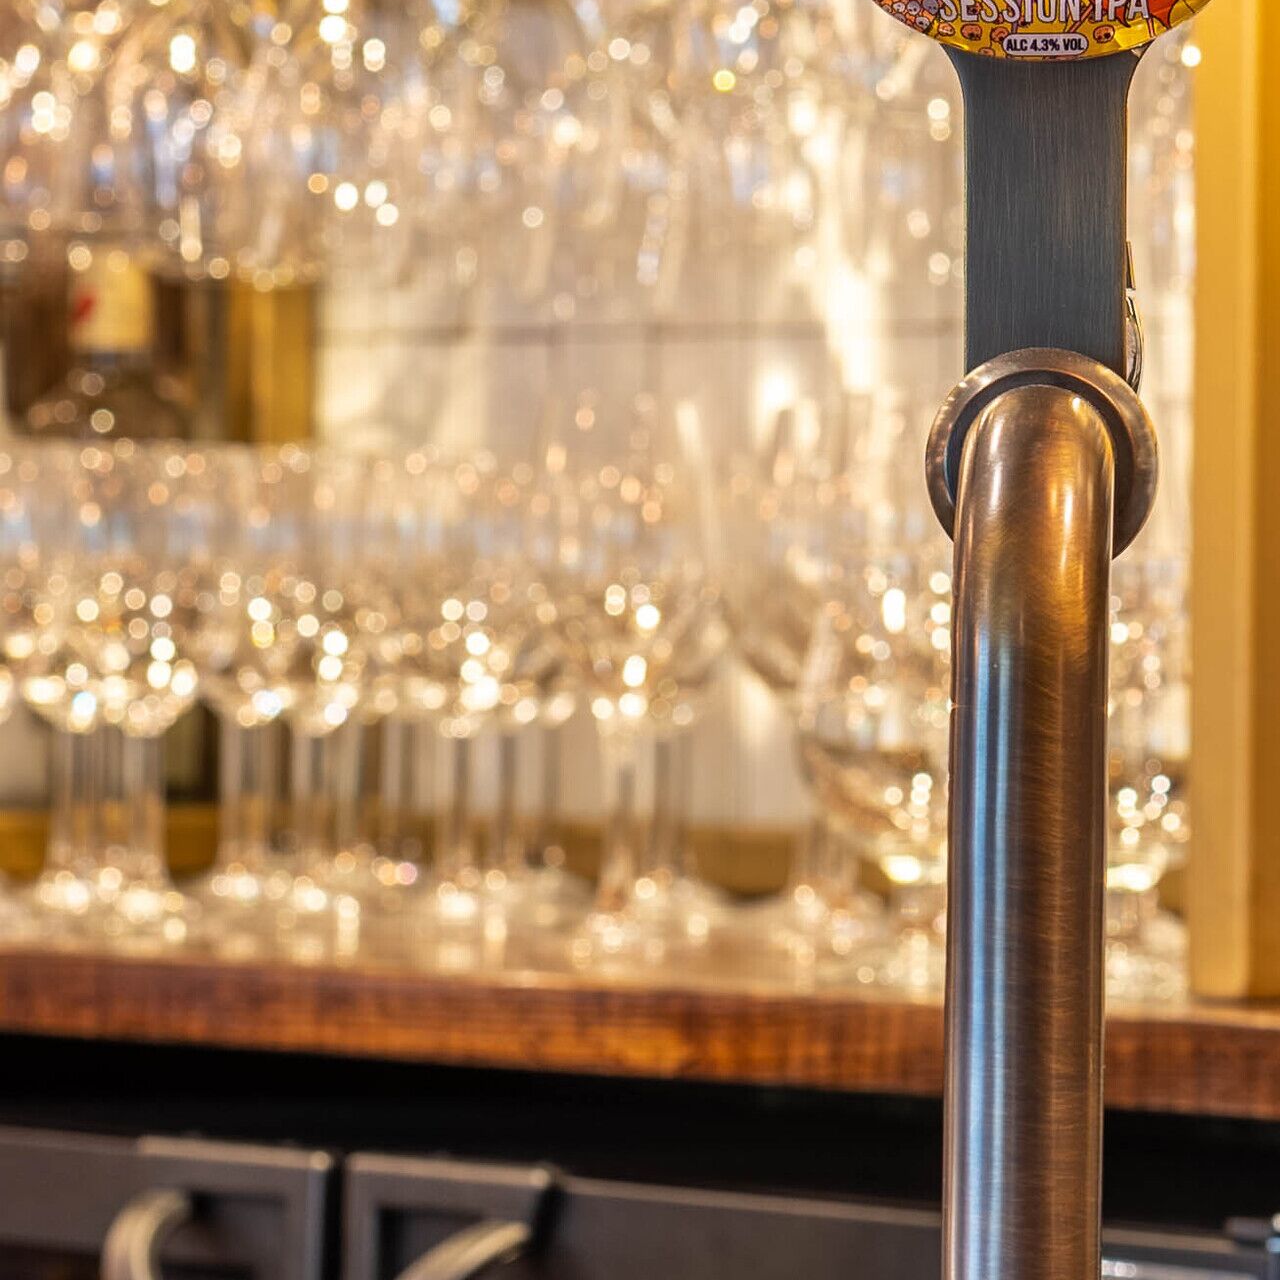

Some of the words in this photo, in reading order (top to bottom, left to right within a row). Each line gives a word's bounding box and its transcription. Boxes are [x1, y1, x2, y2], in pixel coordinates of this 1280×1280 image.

[1006, 39, 1028, 51] ALC
[1030, 39, 1060, 51] 4.3%
[1062, 38, 1084, 51] VOL
